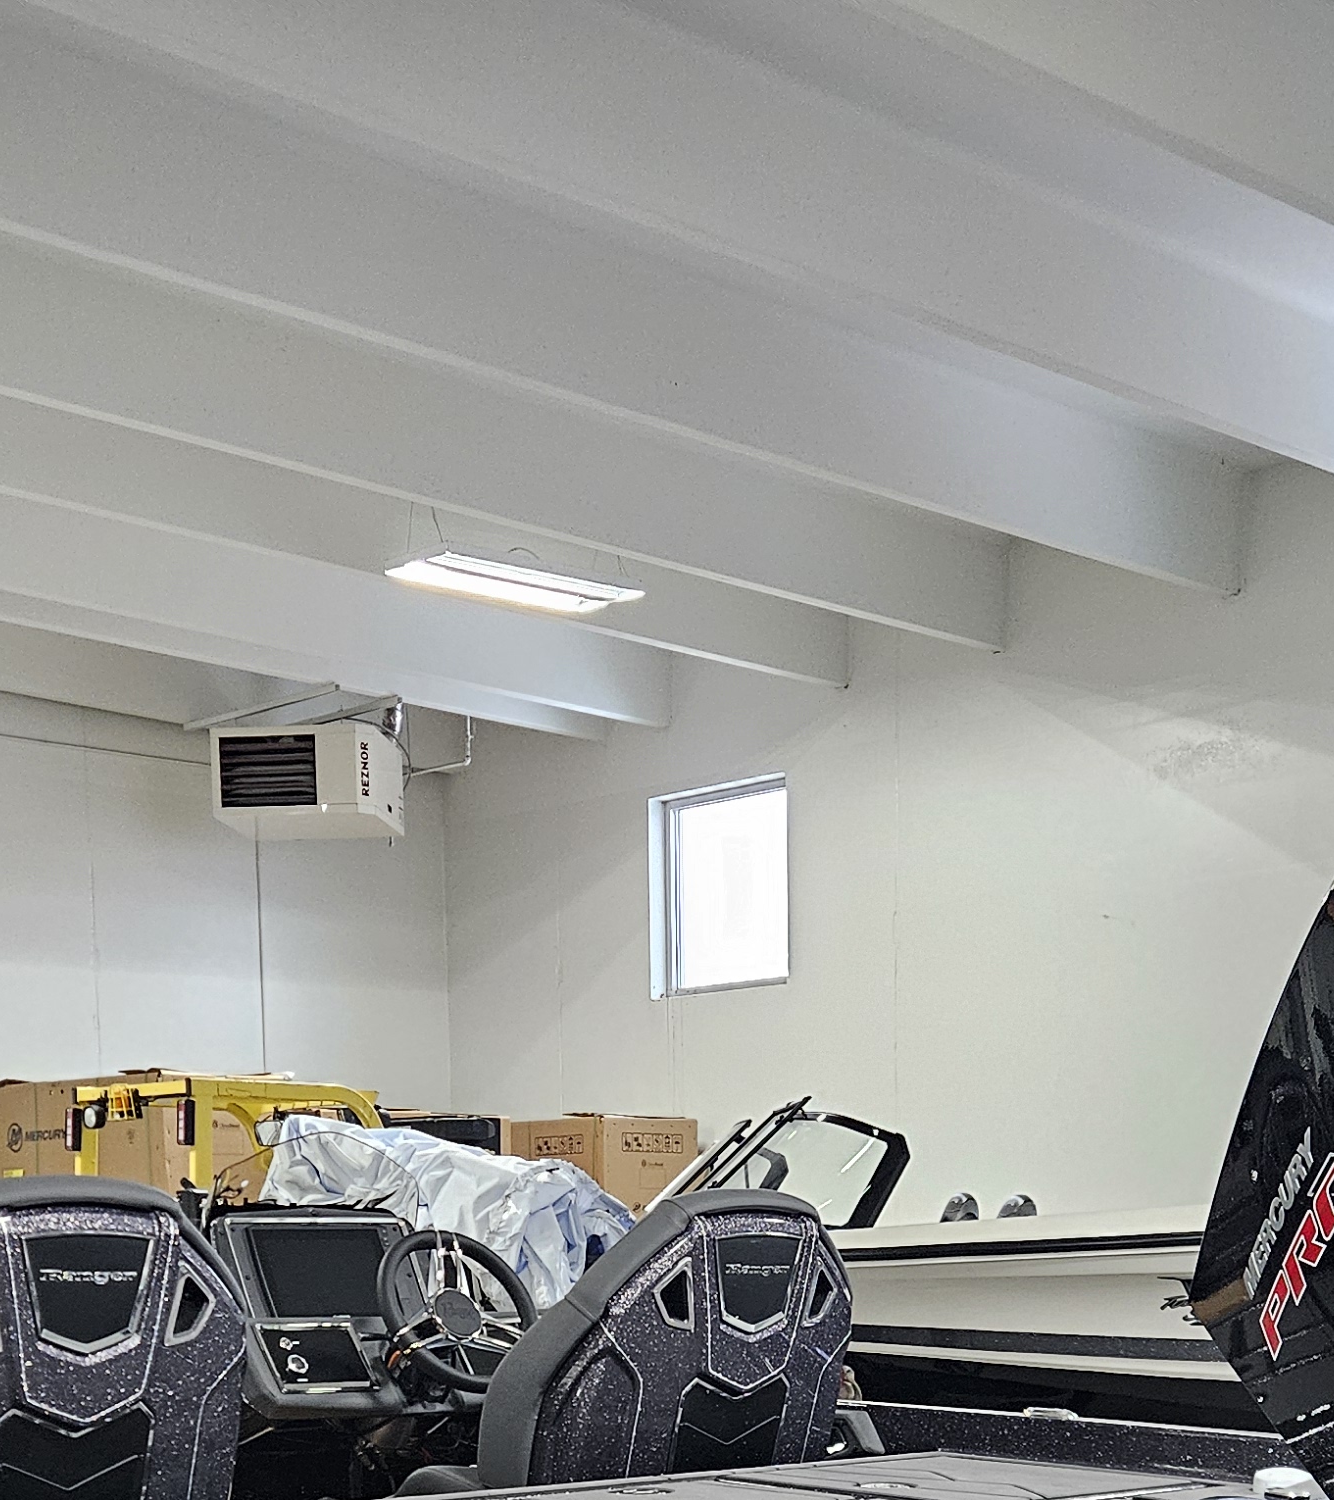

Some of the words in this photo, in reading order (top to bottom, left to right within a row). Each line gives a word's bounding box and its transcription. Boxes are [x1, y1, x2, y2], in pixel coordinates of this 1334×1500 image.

[359, 742, 370, 797] REZNOR
[1242, 1126, 1315, 1301] MERCURY
[39, 1268, 138, 1286] Ranger
